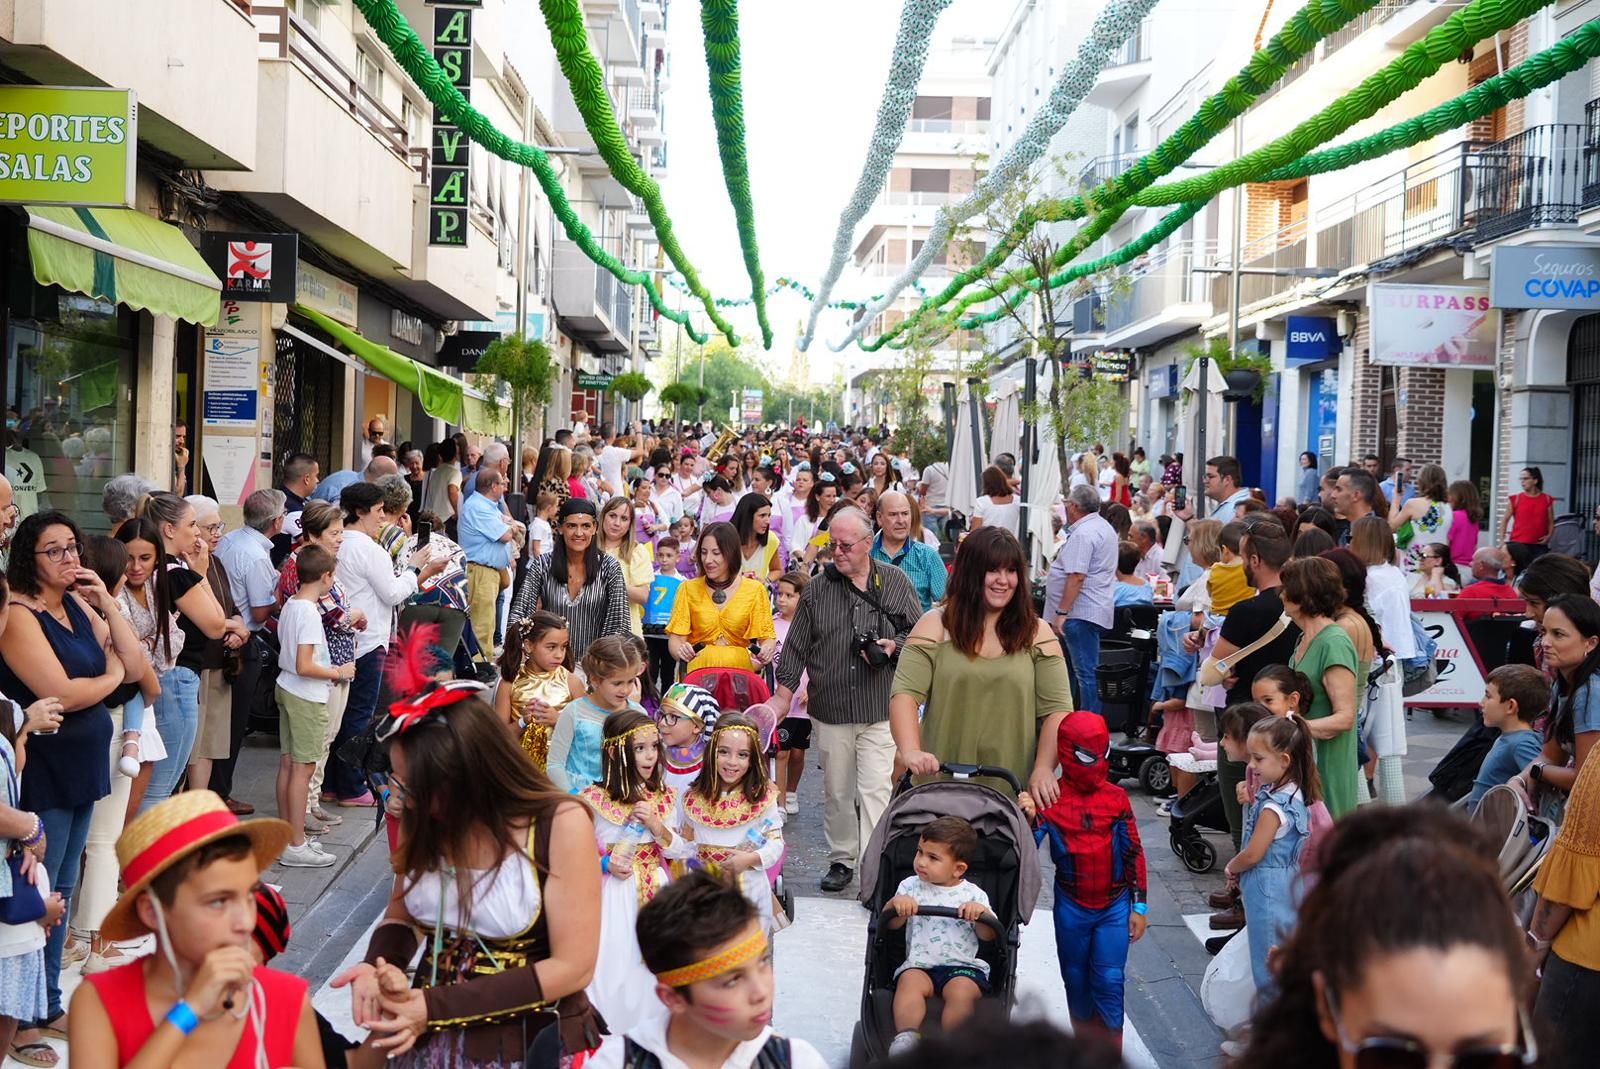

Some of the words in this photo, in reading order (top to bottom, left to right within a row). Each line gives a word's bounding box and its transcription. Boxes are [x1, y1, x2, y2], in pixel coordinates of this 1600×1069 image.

[0, 153, 92, 183] SALAS
[1529, 253, 1594, 286] Seguros
[227, 278, 271, 289] KARMA
[1524, 279, 1600, 298] COVAP
[1290, 331, 1326, 343] BBVA
[654, 586, 667, 605] 7
